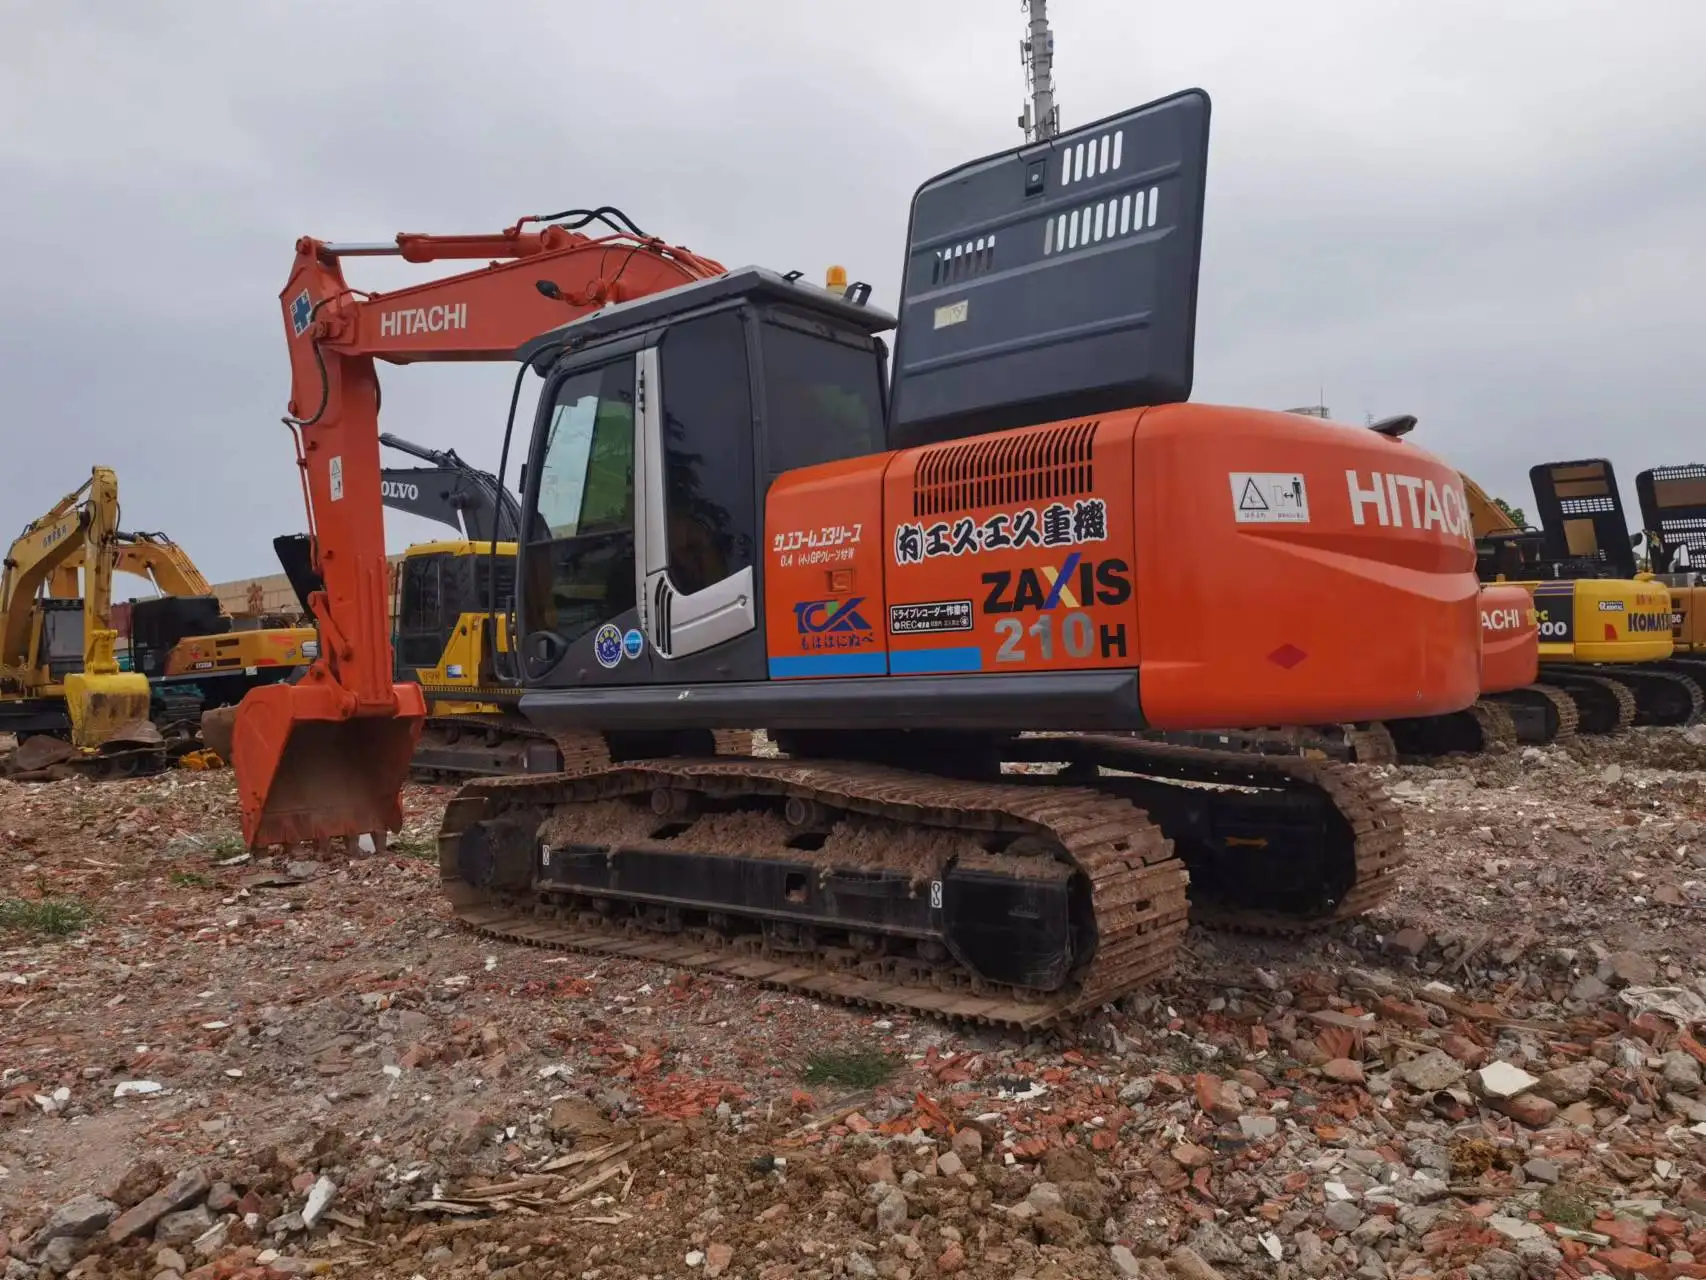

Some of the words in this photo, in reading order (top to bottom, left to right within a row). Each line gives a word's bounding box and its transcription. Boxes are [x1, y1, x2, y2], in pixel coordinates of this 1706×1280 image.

[381, 303, 467, 337] HITACHI
[981, 551, 1131, 614] ZAXIS
[994, 612, 1095, 663] 210
[1100, 623, 1127, 658] H
